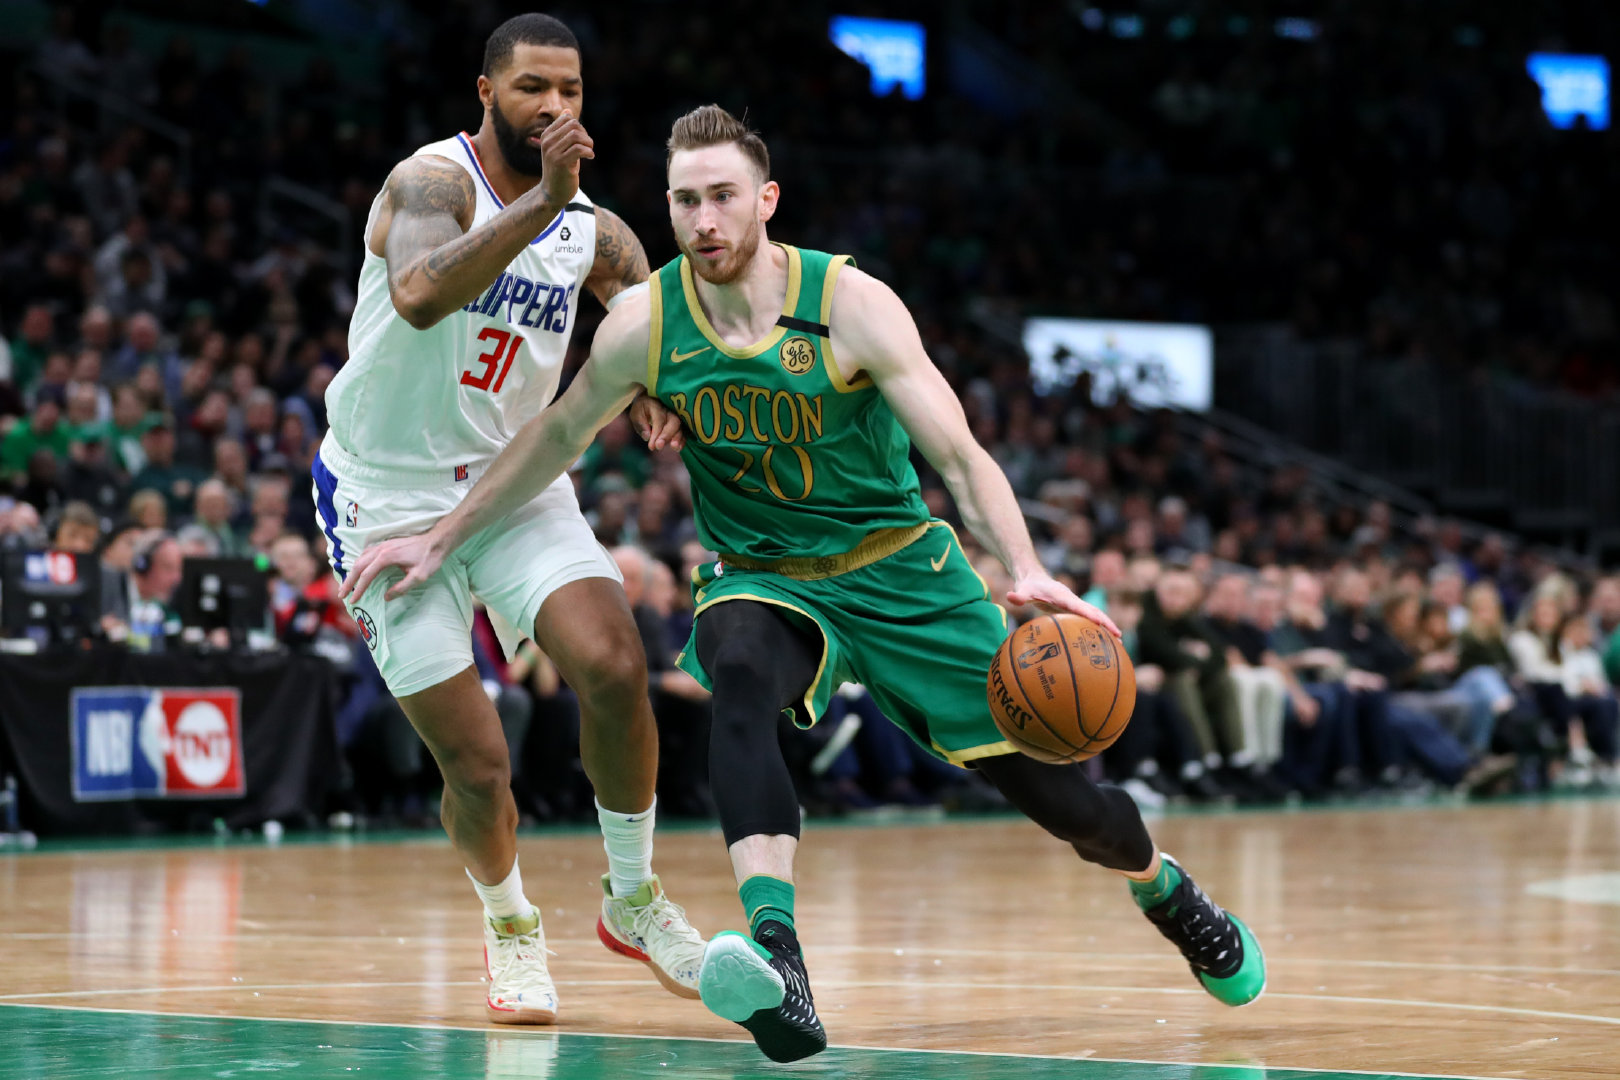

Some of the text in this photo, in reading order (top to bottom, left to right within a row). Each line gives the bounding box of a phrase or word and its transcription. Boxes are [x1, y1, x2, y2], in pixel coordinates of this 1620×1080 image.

[462, 271, 576, 333] IPPERS
[460, 327, 524, 393] 31
[670, 384, 823, 445] BOSTON
[725, 444, 815, 501] 20
